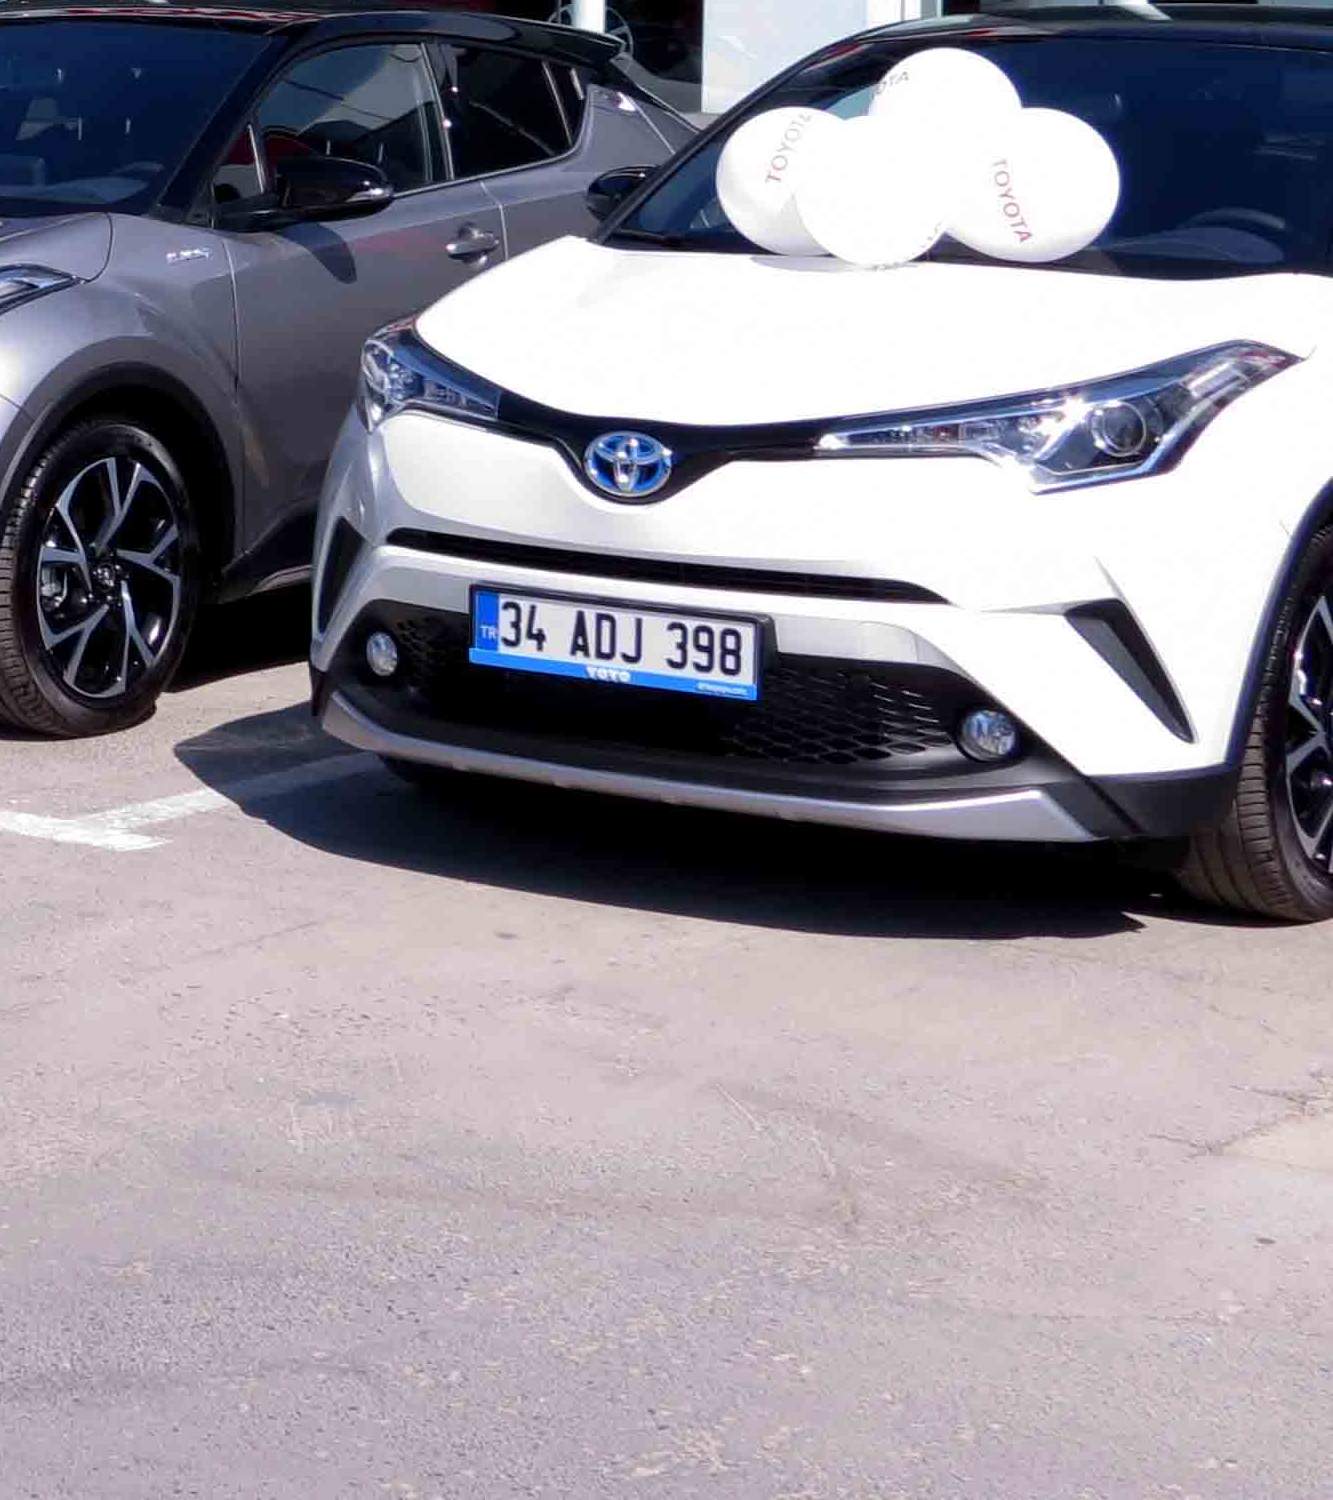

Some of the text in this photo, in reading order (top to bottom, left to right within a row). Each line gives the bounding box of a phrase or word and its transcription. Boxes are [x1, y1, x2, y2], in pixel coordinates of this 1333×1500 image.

[991, 156, 1033, 244] TOYOTA
[480, 625, 498, 641] TR
[500, 601, 742, 677] 34 ADJ 398
